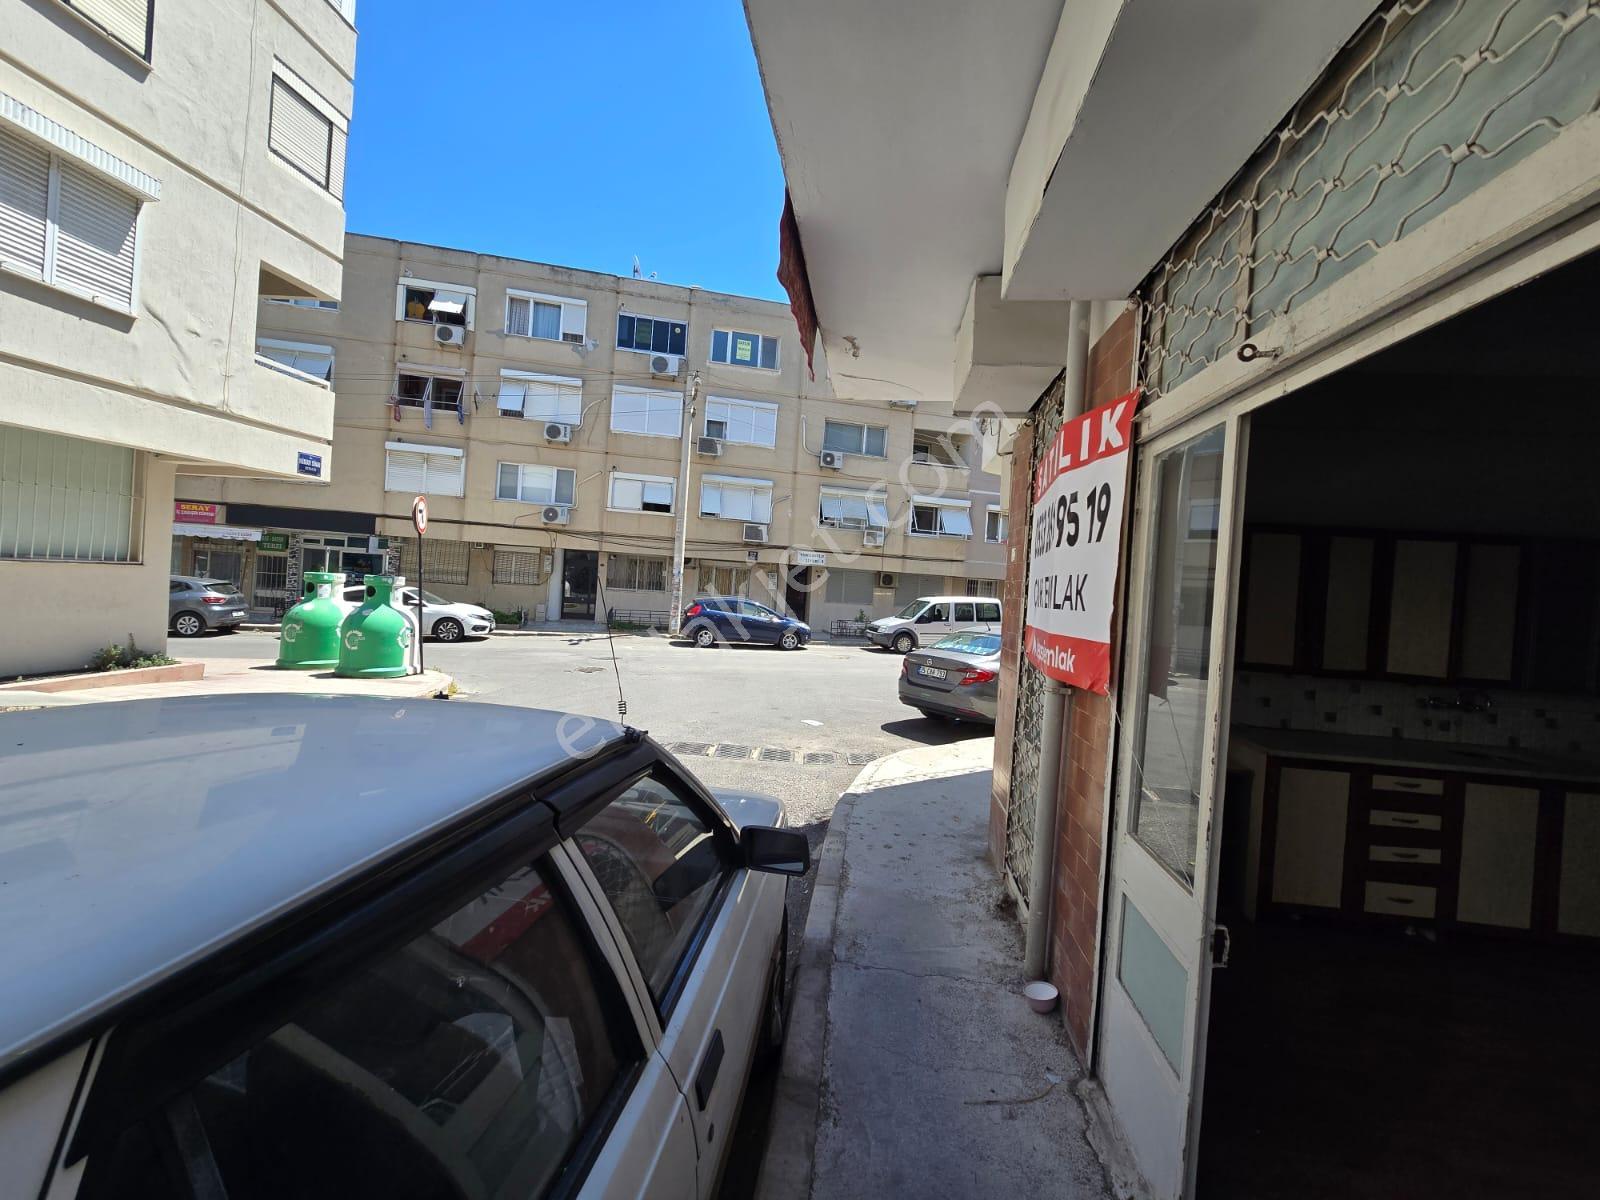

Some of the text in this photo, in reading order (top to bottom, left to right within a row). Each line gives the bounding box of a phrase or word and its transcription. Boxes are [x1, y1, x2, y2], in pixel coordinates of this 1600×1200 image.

[1037, 400, 1128, 498] SATILIK
[1056, 491, 1079, 547] 95
[1086, 482, 1111, 543] 19
